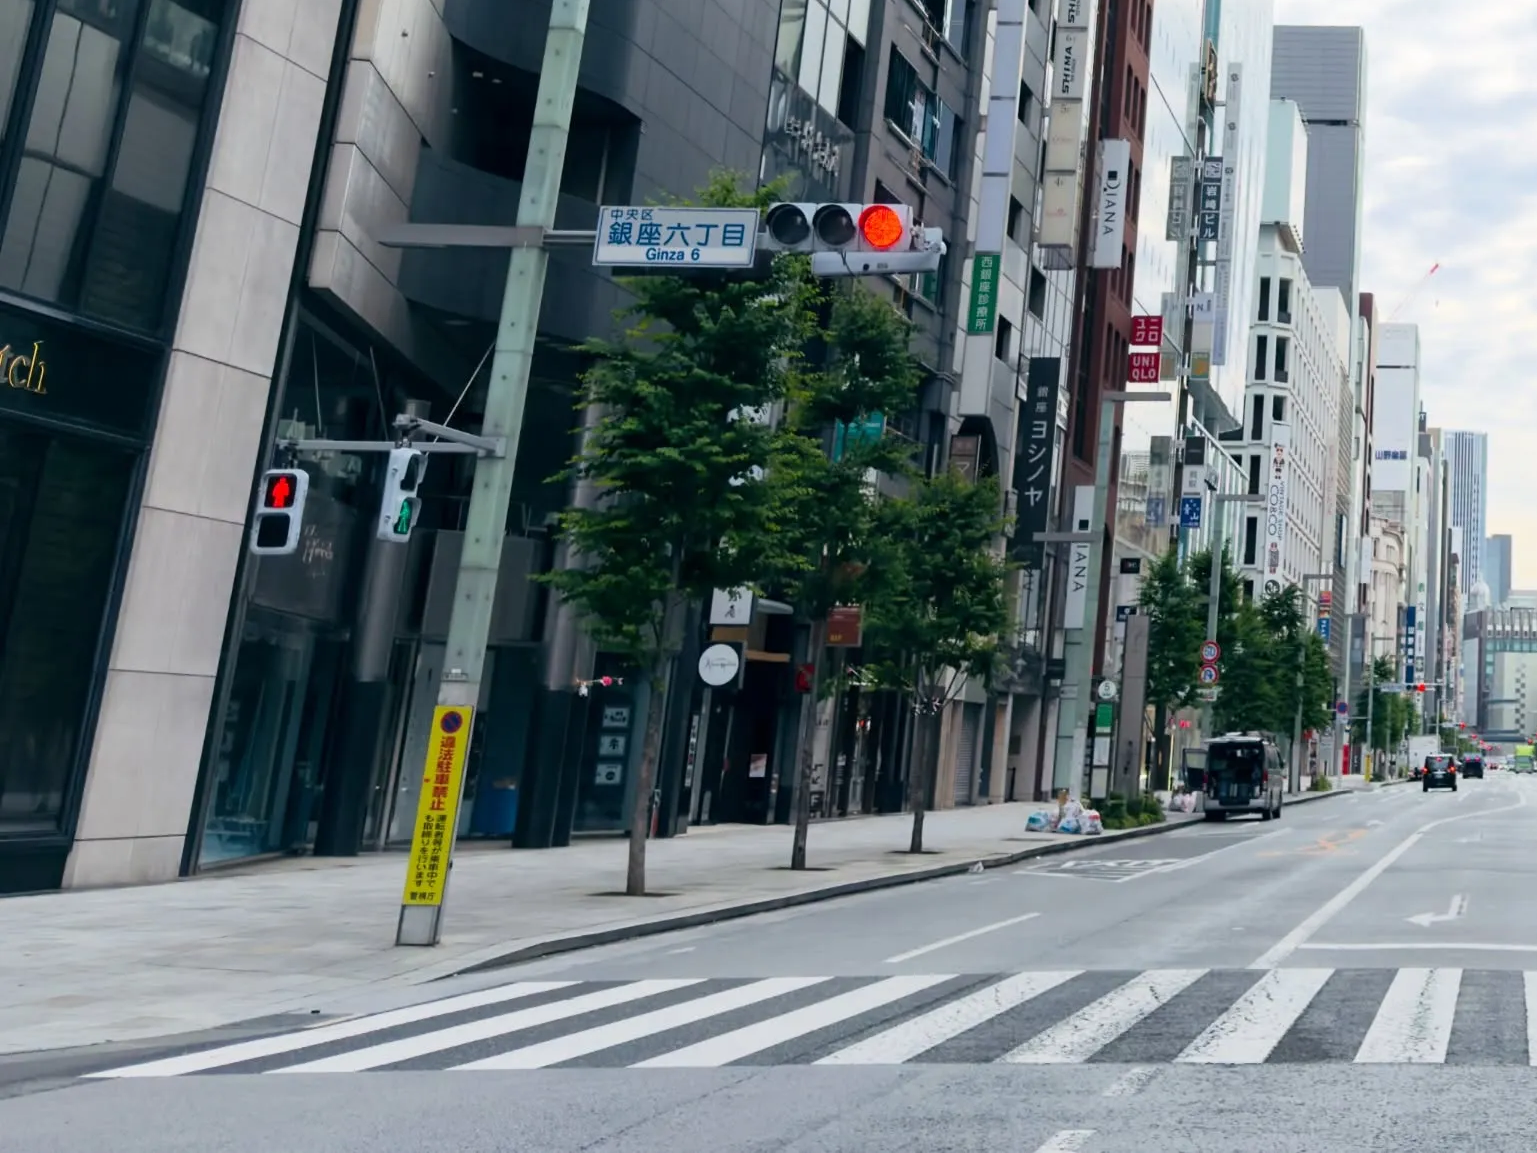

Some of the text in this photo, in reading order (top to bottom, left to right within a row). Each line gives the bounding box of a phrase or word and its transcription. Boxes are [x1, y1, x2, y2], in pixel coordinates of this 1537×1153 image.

[1061, 46, 1072, 94] SHIMA
[610, 209, 654, 221] 中央区
[1103, 171, 1121, 236] DIANA
[608, 222, 745, 247] 銀座六丁目
[646, 248, 700, 261] Ginza 6
[975, 256, 993, 330] 西銀座診療所
[1132, 356, 1155, 367] UNI
[1132, 368, 1156, 380] QLO
[430, 736, 456, 811] 違法駐車禁止
